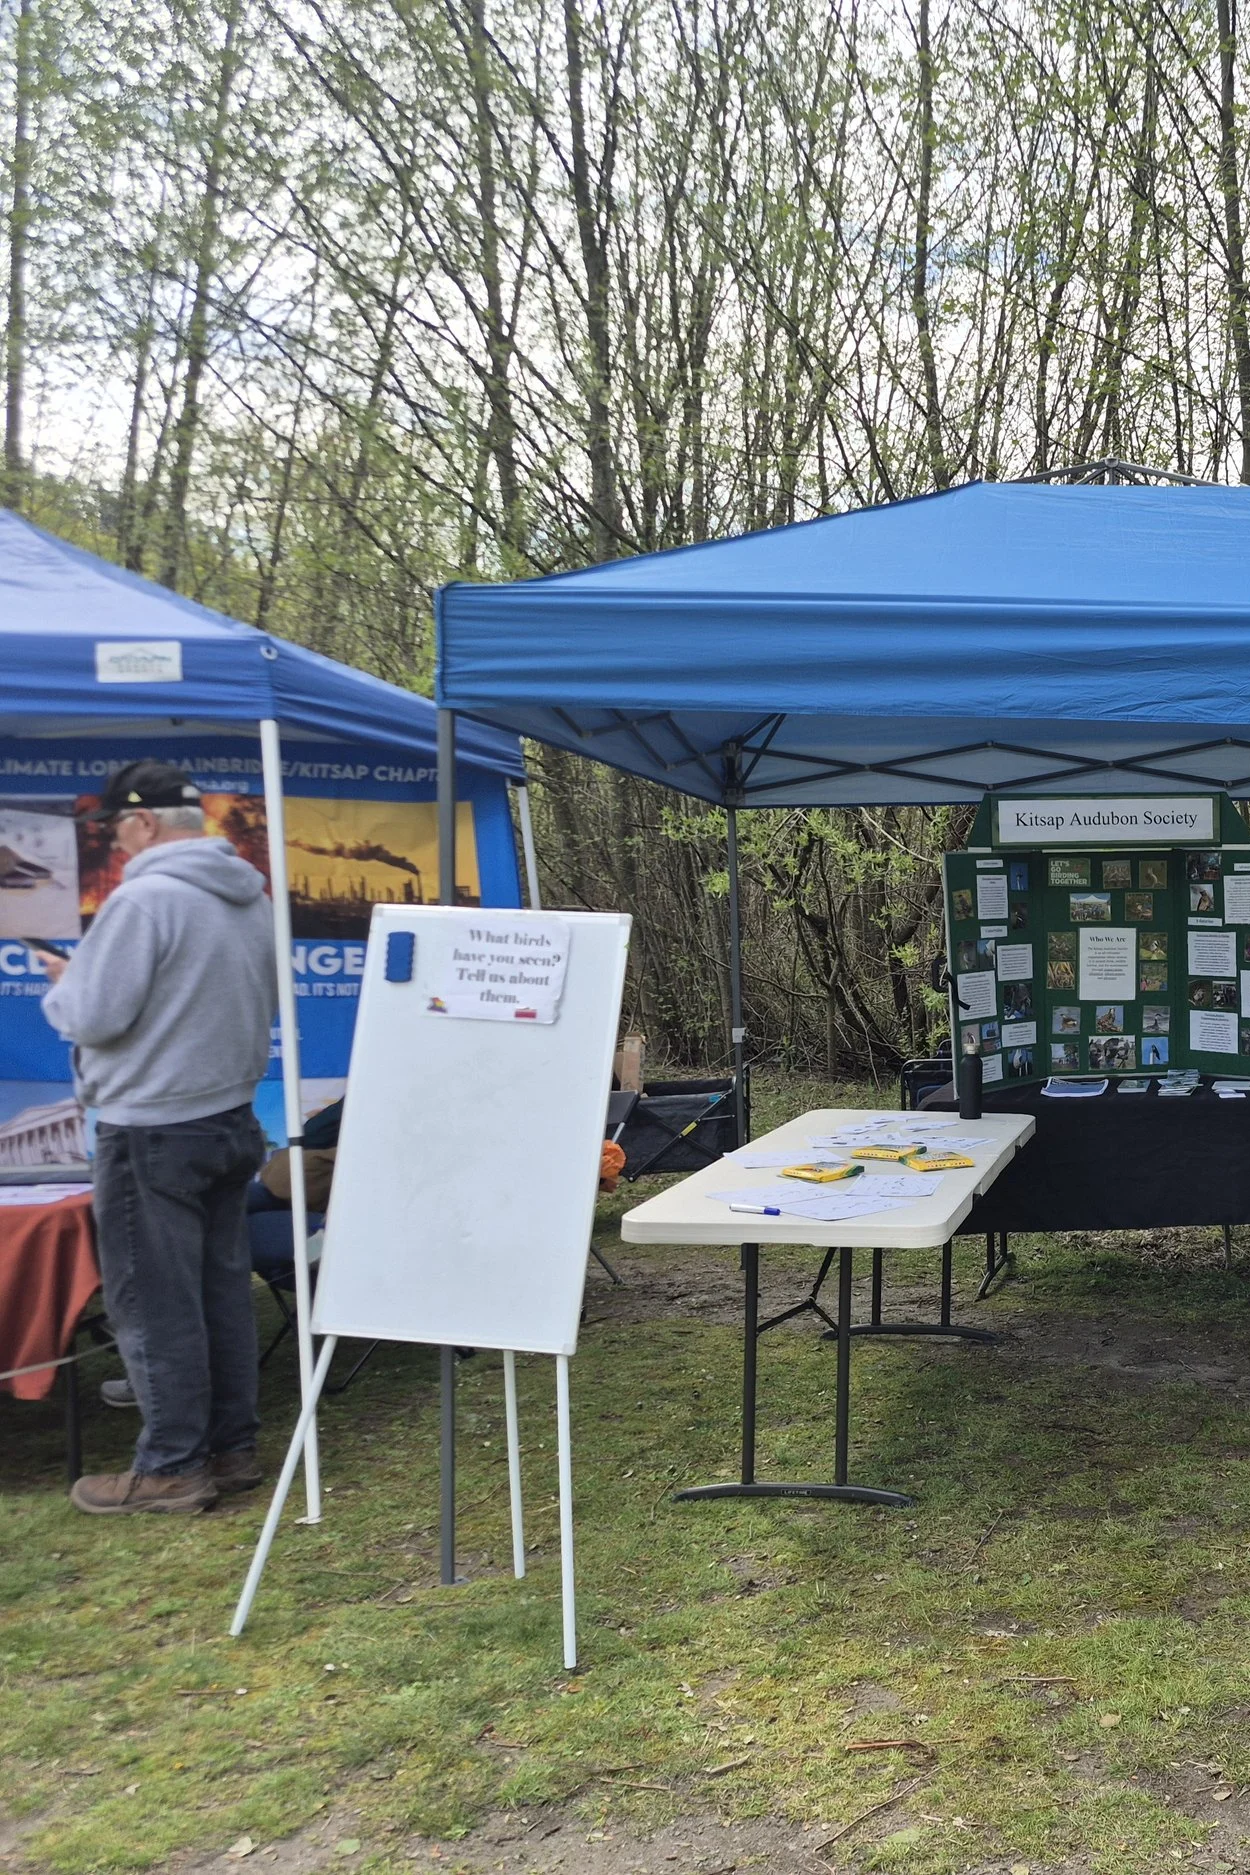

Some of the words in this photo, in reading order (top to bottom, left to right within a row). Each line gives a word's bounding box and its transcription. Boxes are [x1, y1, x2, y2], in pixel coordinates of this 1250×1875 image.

[373, 764, 442, 782] CHAPT
[1015, 811, 1065, 831] Kitsap
[1069, 811, 1138, 827] Audubon
[1143, 810, 1198, 828] Society
[469, 928, 510, 946] What
[513, 931, 551, 948] birds
[452, 947, 486, 963] have
[487, 953, 515, 967] you
[517, 953, 562, 968] seen?
[456, 966, 487, 983] Tell
[488, 972, 506, 984] us
[508, 971, 550, 987] about
[479, 988, 521, 1005] them.
